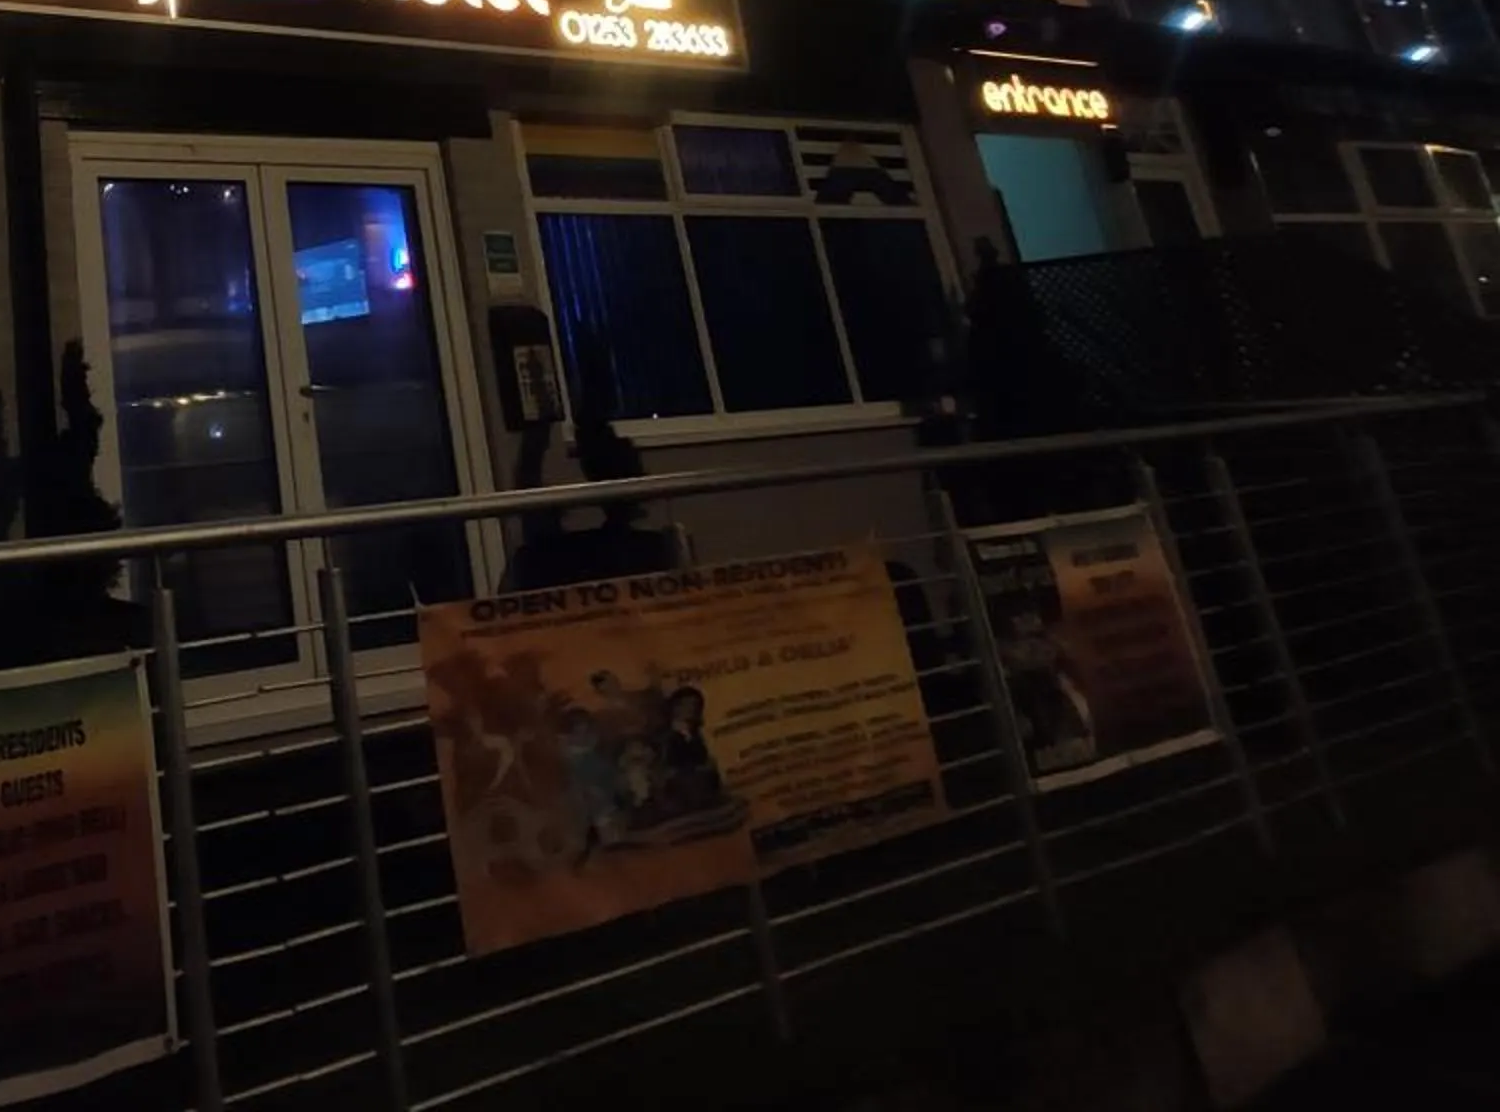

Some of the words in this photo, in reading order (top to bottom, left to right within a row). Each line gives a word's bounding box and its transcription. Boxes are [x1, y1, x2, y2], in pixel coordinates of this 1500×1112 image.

[981, 73, 1108, 119] entrance
[470, 590, 569, 624] OPEN
[577, 581, 618, 610] TO
[1, 768, 64, 807] GUESTS
